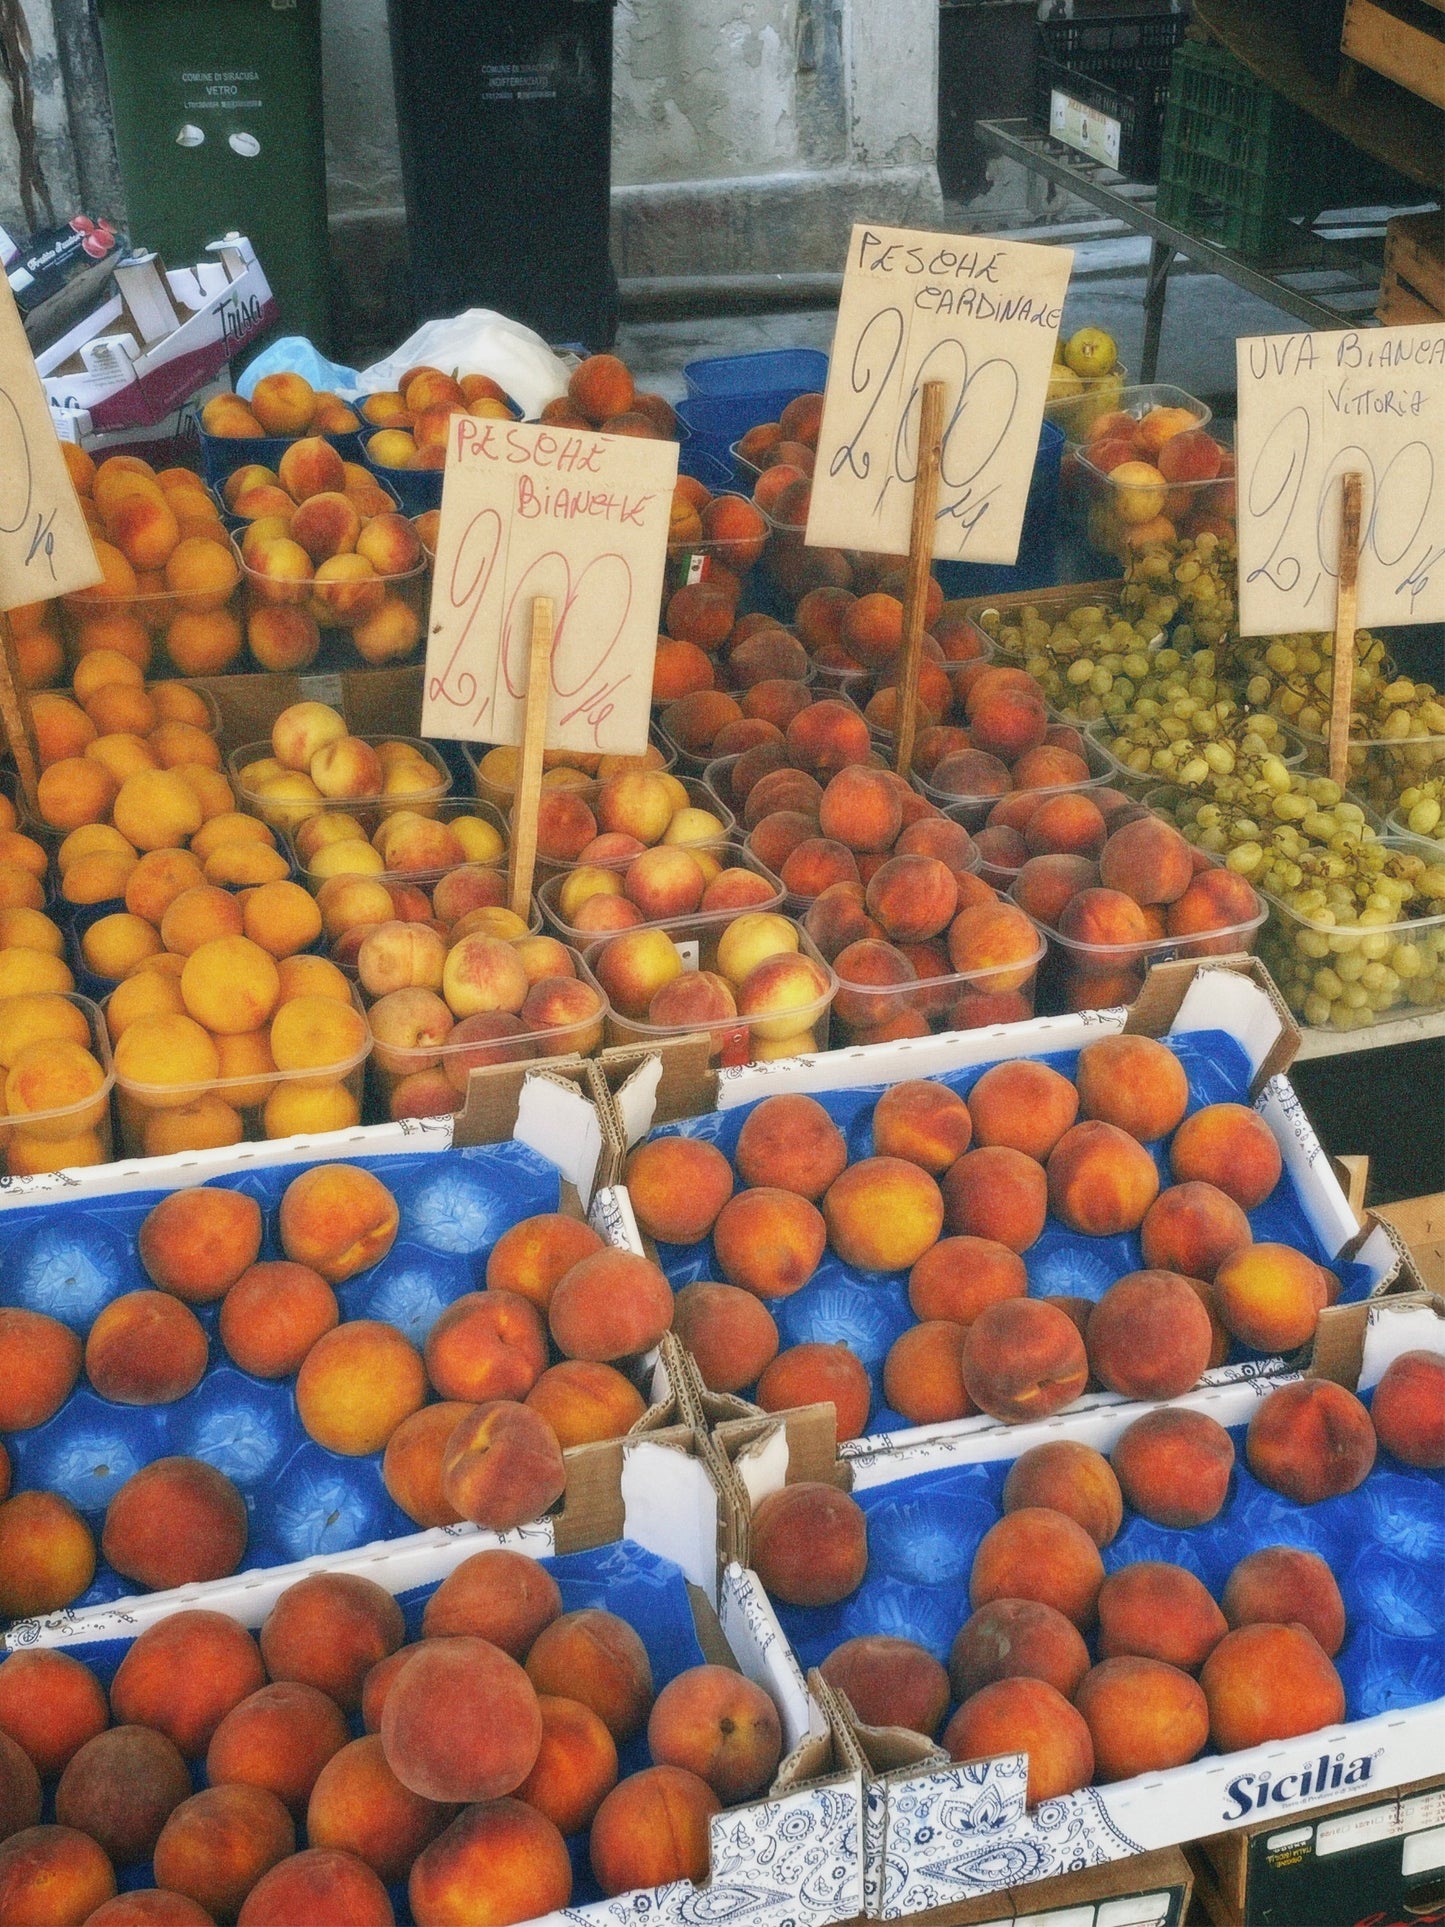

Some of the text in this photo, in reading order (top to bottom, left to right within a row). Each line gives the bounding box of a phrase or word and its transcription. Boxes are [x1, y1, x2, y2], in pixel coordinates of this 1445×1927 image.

[182, 72, 260, 81] COMUNE DI SIRACUSA
[206, 85, 238, 95] VETRO
[1249, 334, 1320, 379] UVA
[1222, 1752, 1374, 1821] Sicilia
